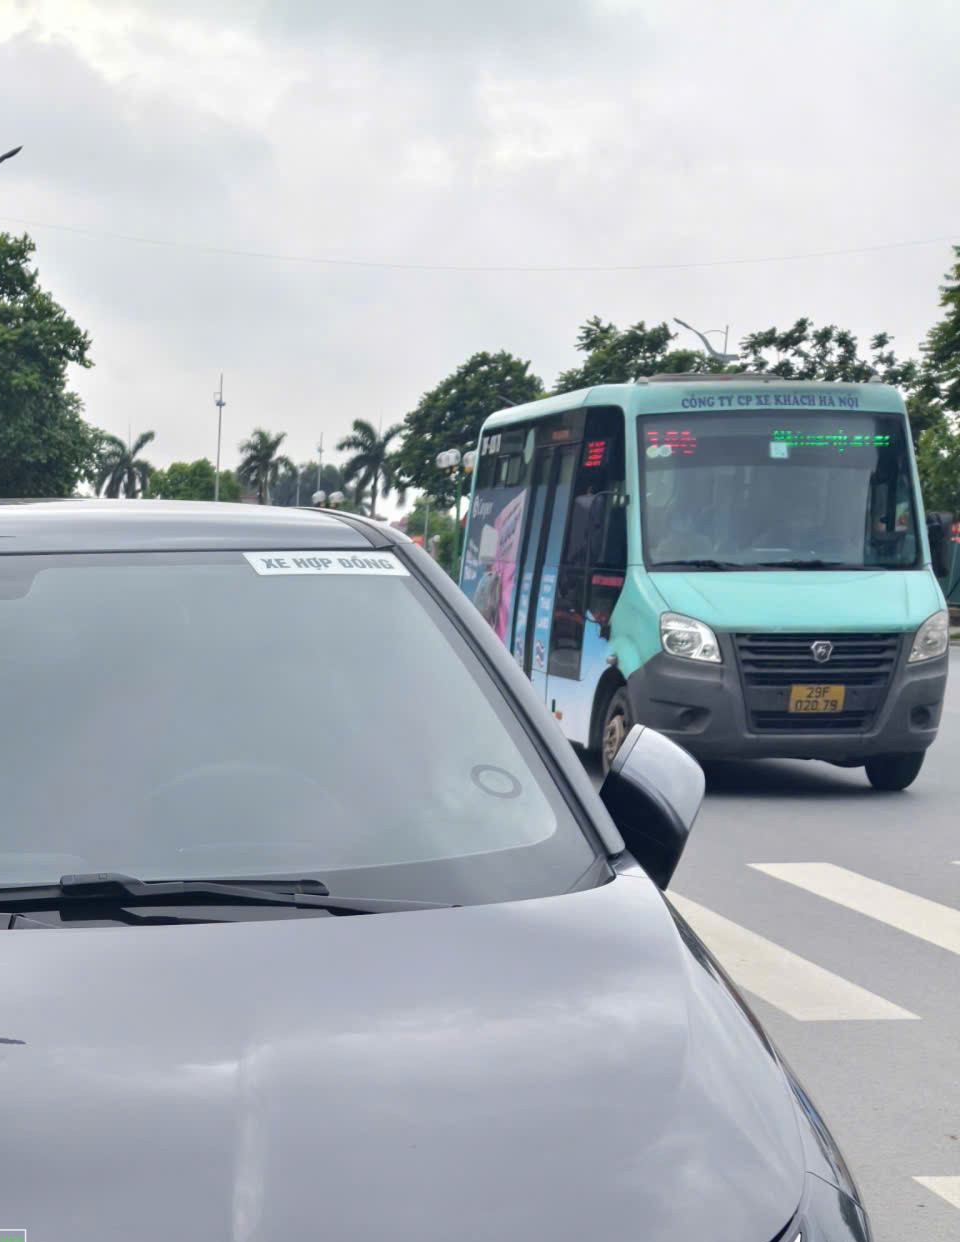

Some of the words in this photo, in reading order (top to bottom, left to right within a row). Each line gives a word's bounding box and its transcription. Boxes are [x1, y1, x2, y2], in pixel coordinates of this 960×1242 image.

[719, 395, 735, 407] TY
[737, 394, 753, 407] CP
[755, 394, 773, 406] XE
[260, 558, 291, 569] XE
[292, 556, 333, 570] HỢP
[337, 555, 396, 570] ĐỒNG
